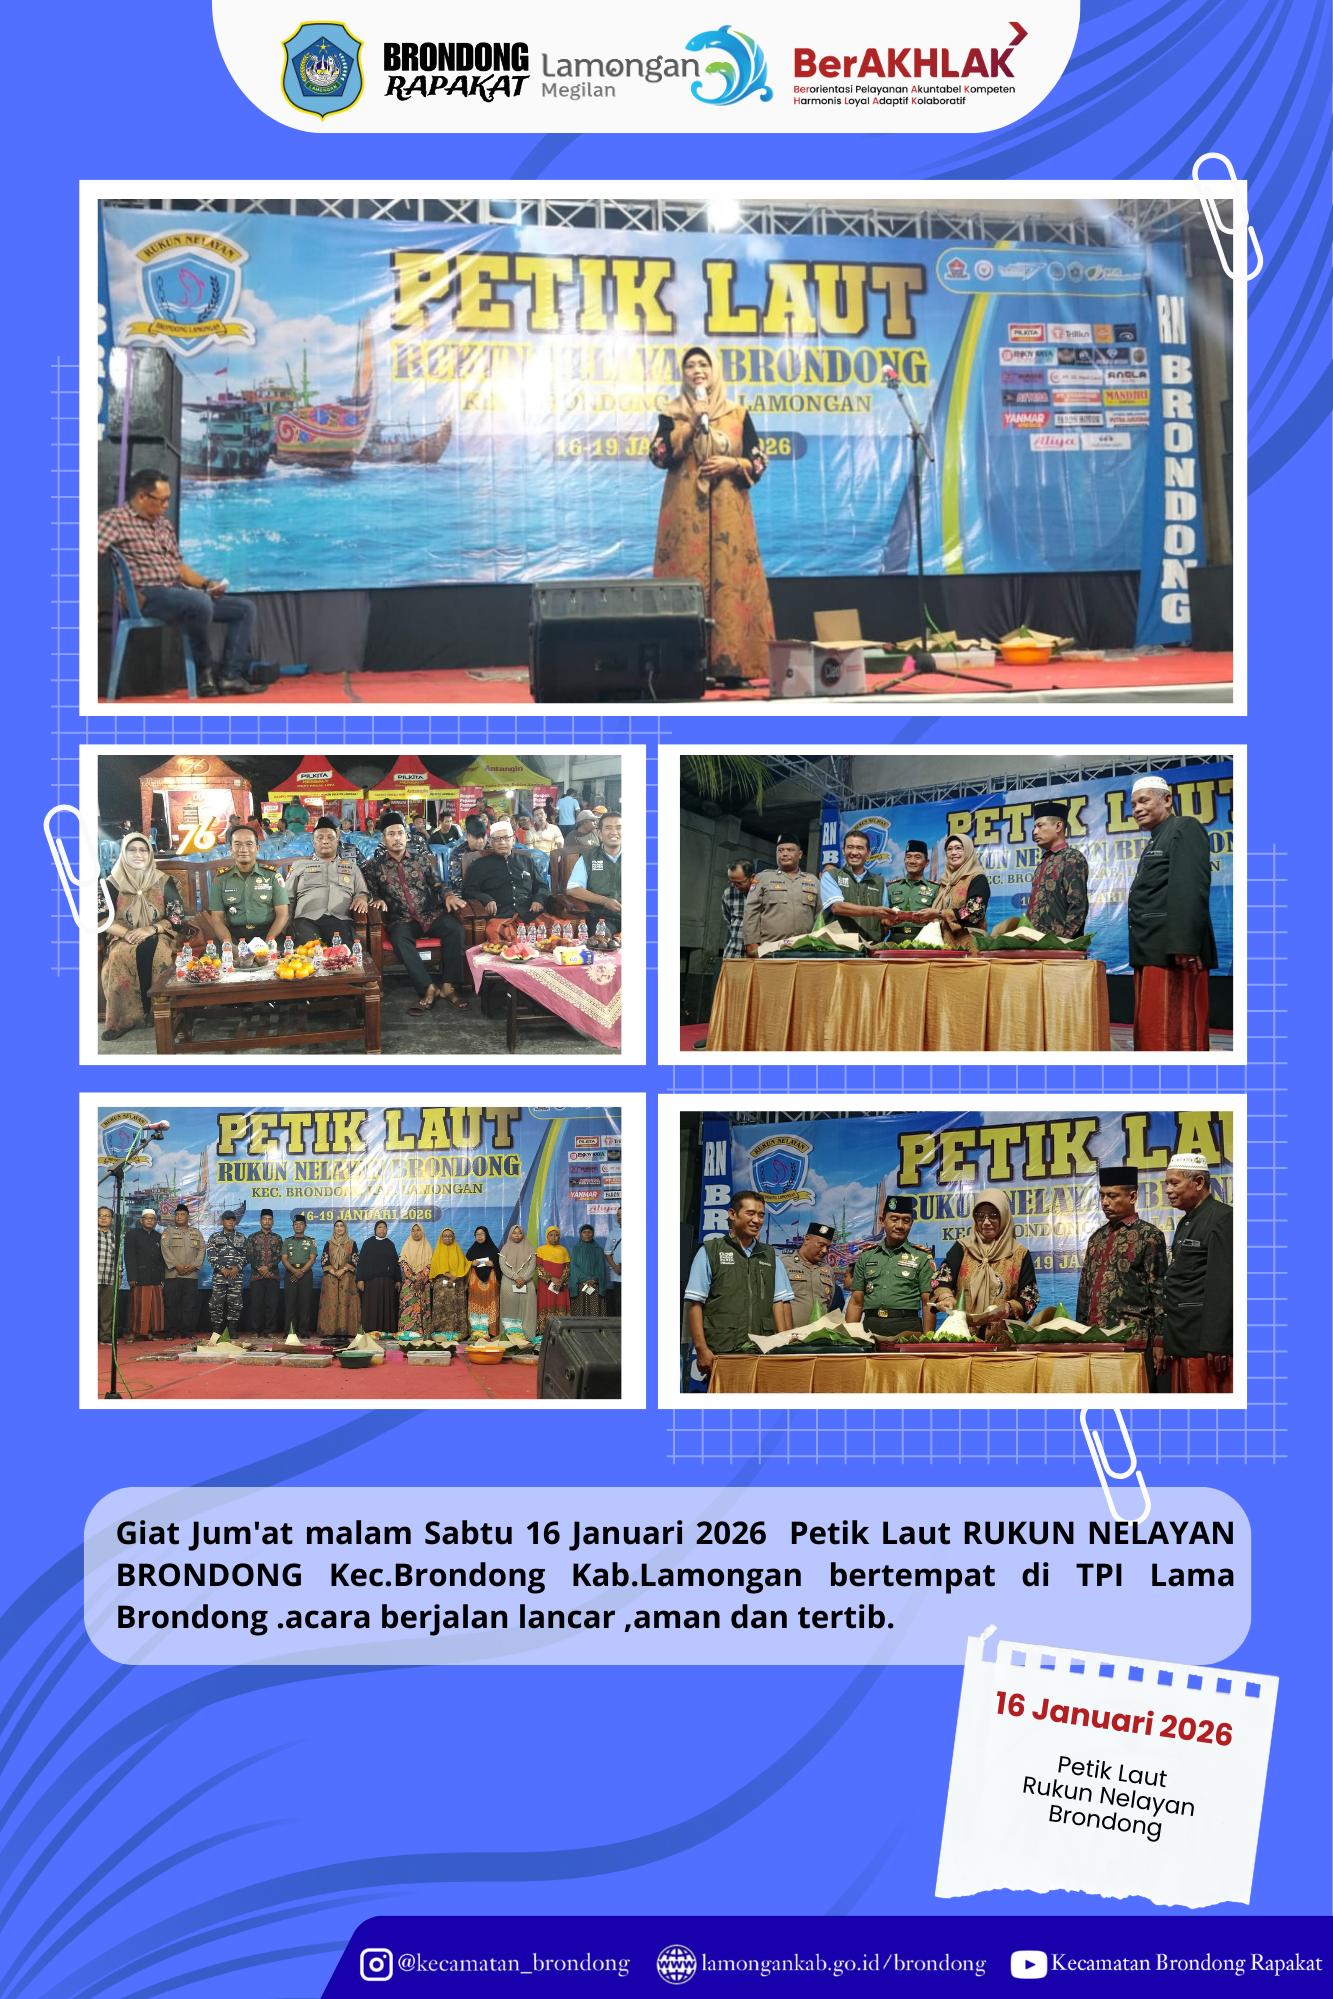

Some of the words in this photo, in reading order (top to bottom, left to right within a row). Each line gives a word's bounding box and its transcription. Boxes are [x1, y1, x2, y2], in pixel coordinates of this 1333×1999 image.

[144, 236, 181, 258] RUKUN
[390, 249, 676, 335] PETIK
[702, 258, 927, 339] LAUT
[1157, 295, 1187, 344] RN
[720, 347, 930, 386] BRONDONG
[1004, 413, 1046, 424] YANMAR
[1161, 354, 1198, 625] BRONDONG
[176, 816, 217, 855] 76
[822, 821, 838, 846] RN
[946, 794, 1090, 847] PETK
[216, 1109, 369, 1157] PETIK
[384, 1107, 522, 1152] LAUT
[217, 1161, 288, 1182] RUKUN
[392, 1154, 520, 1178] BRONDONG
[703, 1141, 727, 1177] RN
[897, 1116, 1100, 1188] PETIK
[252, 1186, 282, 1198] KEC.
[402, 1208, 433, 1220] 2026
